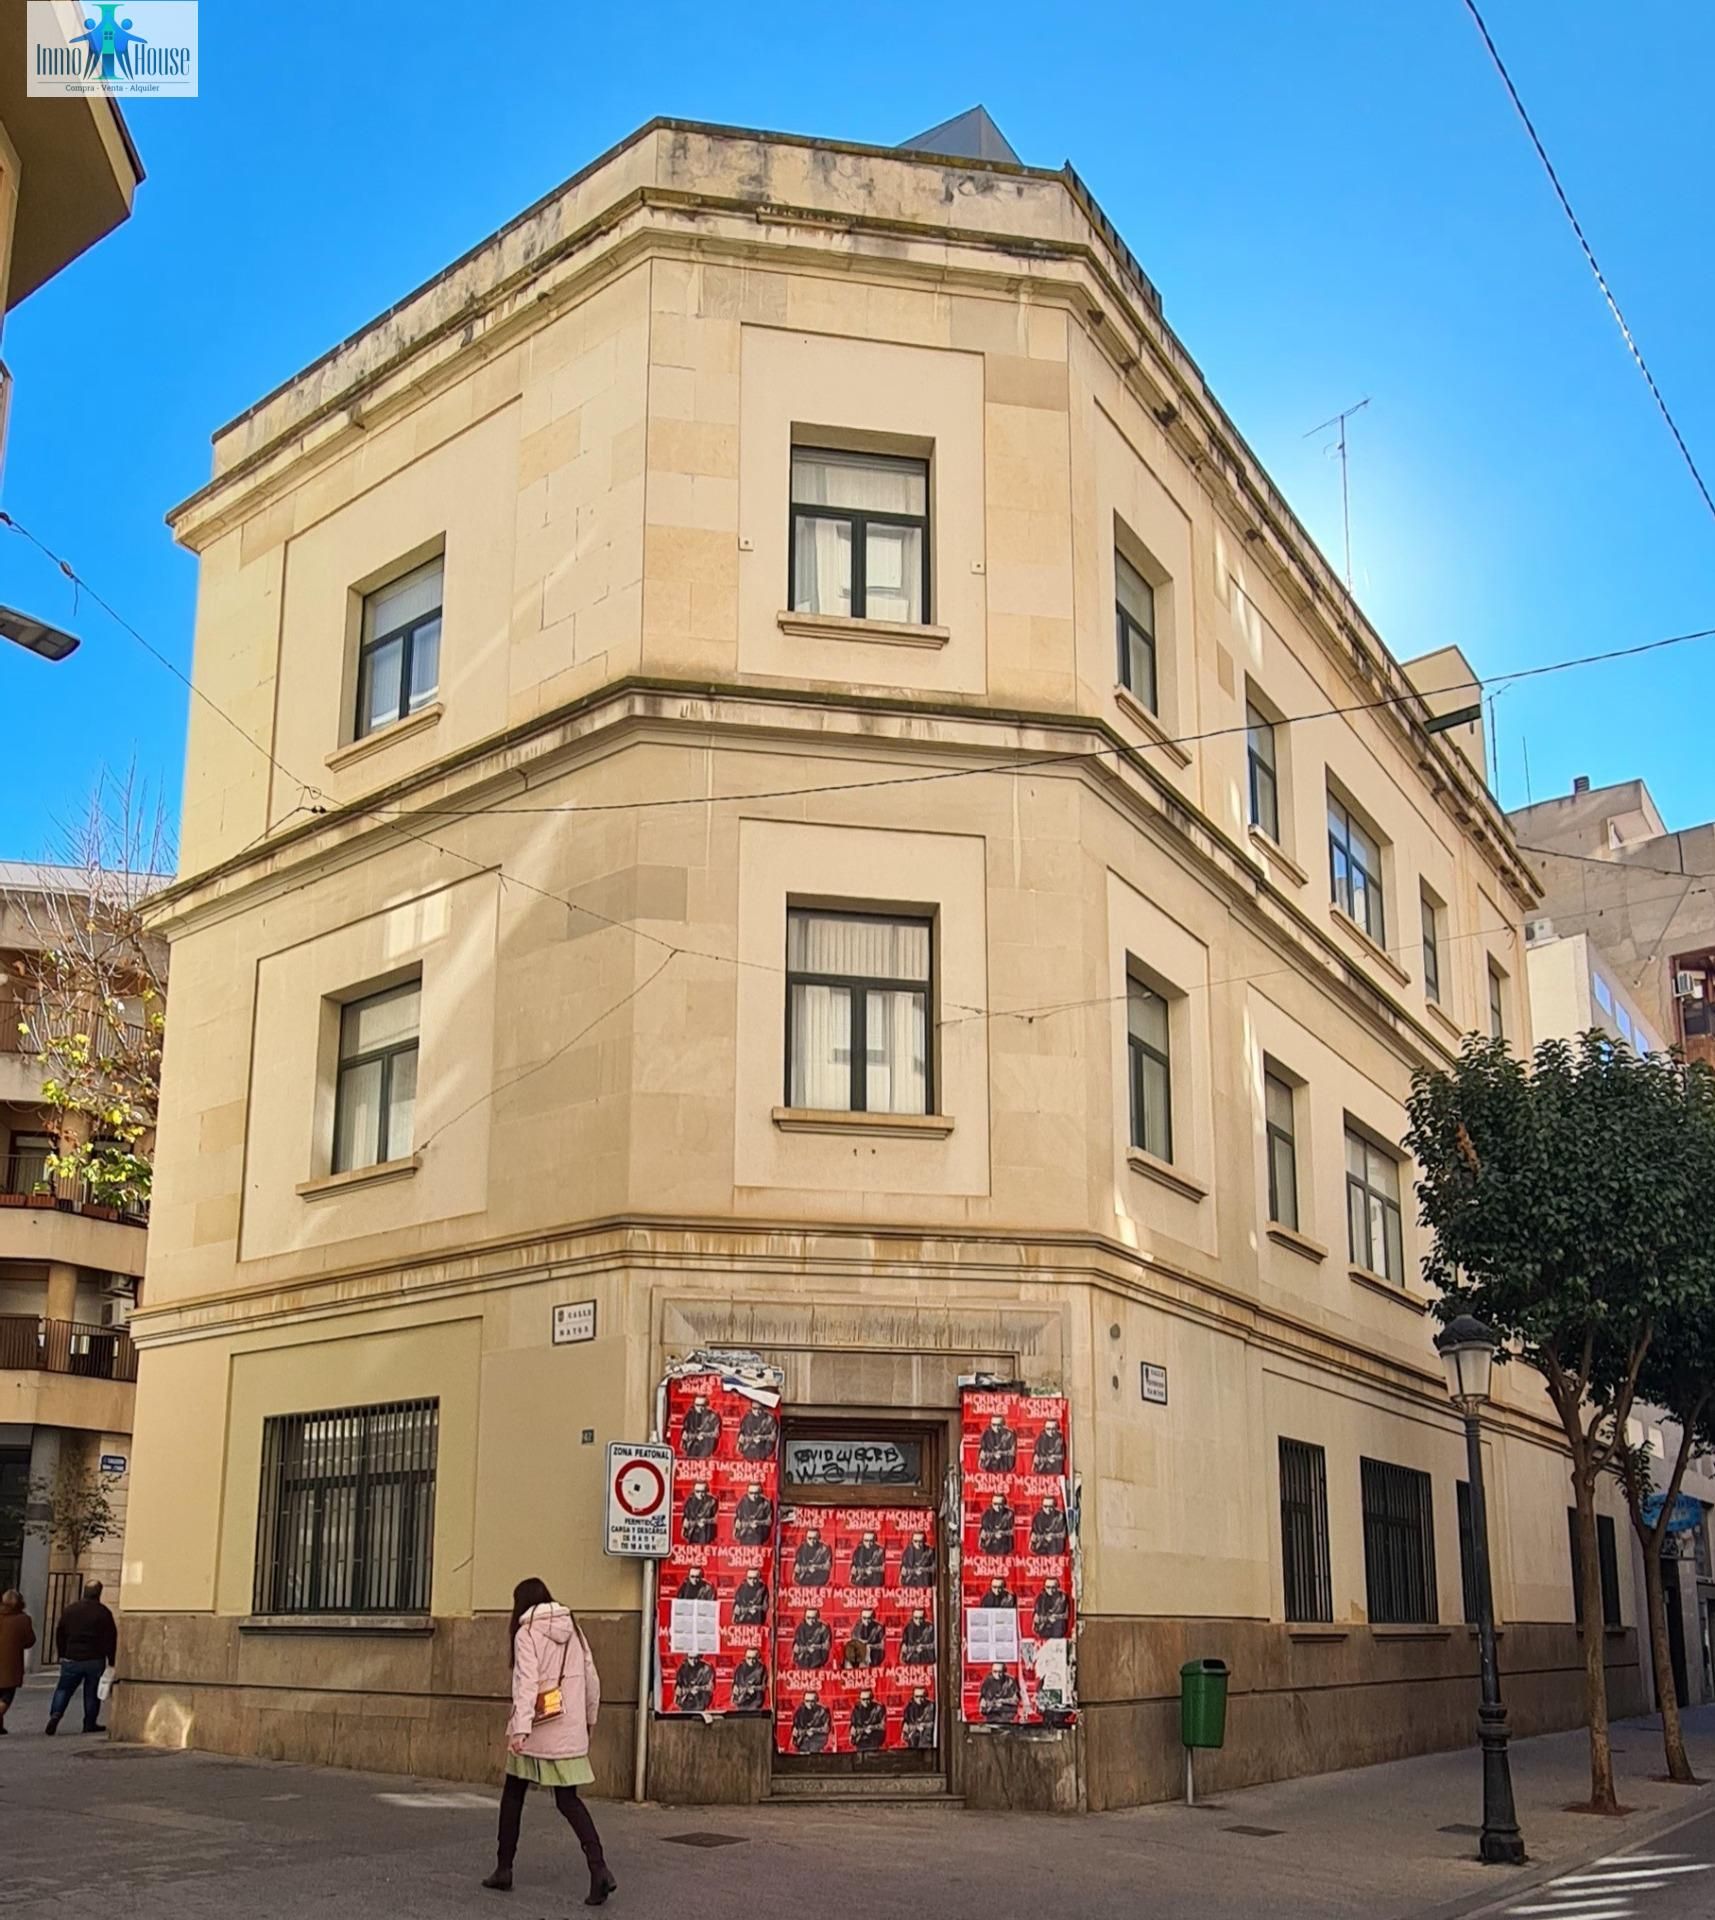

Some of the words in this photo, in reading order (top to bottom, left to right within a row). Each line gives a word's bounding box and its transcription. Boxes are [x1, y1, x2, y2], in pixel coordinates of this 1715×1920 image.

[678, 1383, 714, 1395] JAMES
[963, 1392, 1019, 1405] MCKINLEY
[973, 1403, 1009, 1415] JAMES
[1027, 1406, 1063, 1419] JAMES
[613, 1447, 632, 1457] ZONA
[634, 1448, 670, 1460] PEATONAL
[676, 1466, 713, 1481] JAMES
[718, 1460, 777, 1474] MCKINLEY
[728, 1468, 767, 1483] JAMES
[974, 1480, 1011, 1494] JAMES
[1023, 1484, 1061, 1497] JAMES
[789, 1517, 825, 1529] JAMES
[885, 1511, 933, 1523] MCKINLE
[611, 1525, 630, 1534] CARGA
[637, 1527, 667, 1535] DESCARGA
[845, 1519, 882, 1531] JAMES
[895, 1520, 931, 1532] JAMES
[671, 1544, 717, 1556] CKINLEY
[718, 1545, 773, 1558] MCKINLEY
[671, 1554, 708, 1567] JAMES
[728, 1555, 764, 1568] JAMES
[973, 1564, 1010, 1577] JAMES
[1026, 1564, 1063, 1577] JAMES
[778, 1586, 833, 1599] MCKINLEY
[885, 1587, 932, 1599] MCKINLE
[788, 1596, 824, 1608] JAMES
[843, 1597, 879, 1608] JAMES
[895, 1598, 931, 1608] JAMES
[776, 1669, 832, 1682] MCKINLEY
[831, 1667, 884, 1682] MCKINLEY
[885, 1665, 933, 1677] MCKINLE
[786, 1679, 822, 1691] JAMES
[841, 1677, 876, 1690] JAMES
[895, 1674, 931, 1687] JAMES
